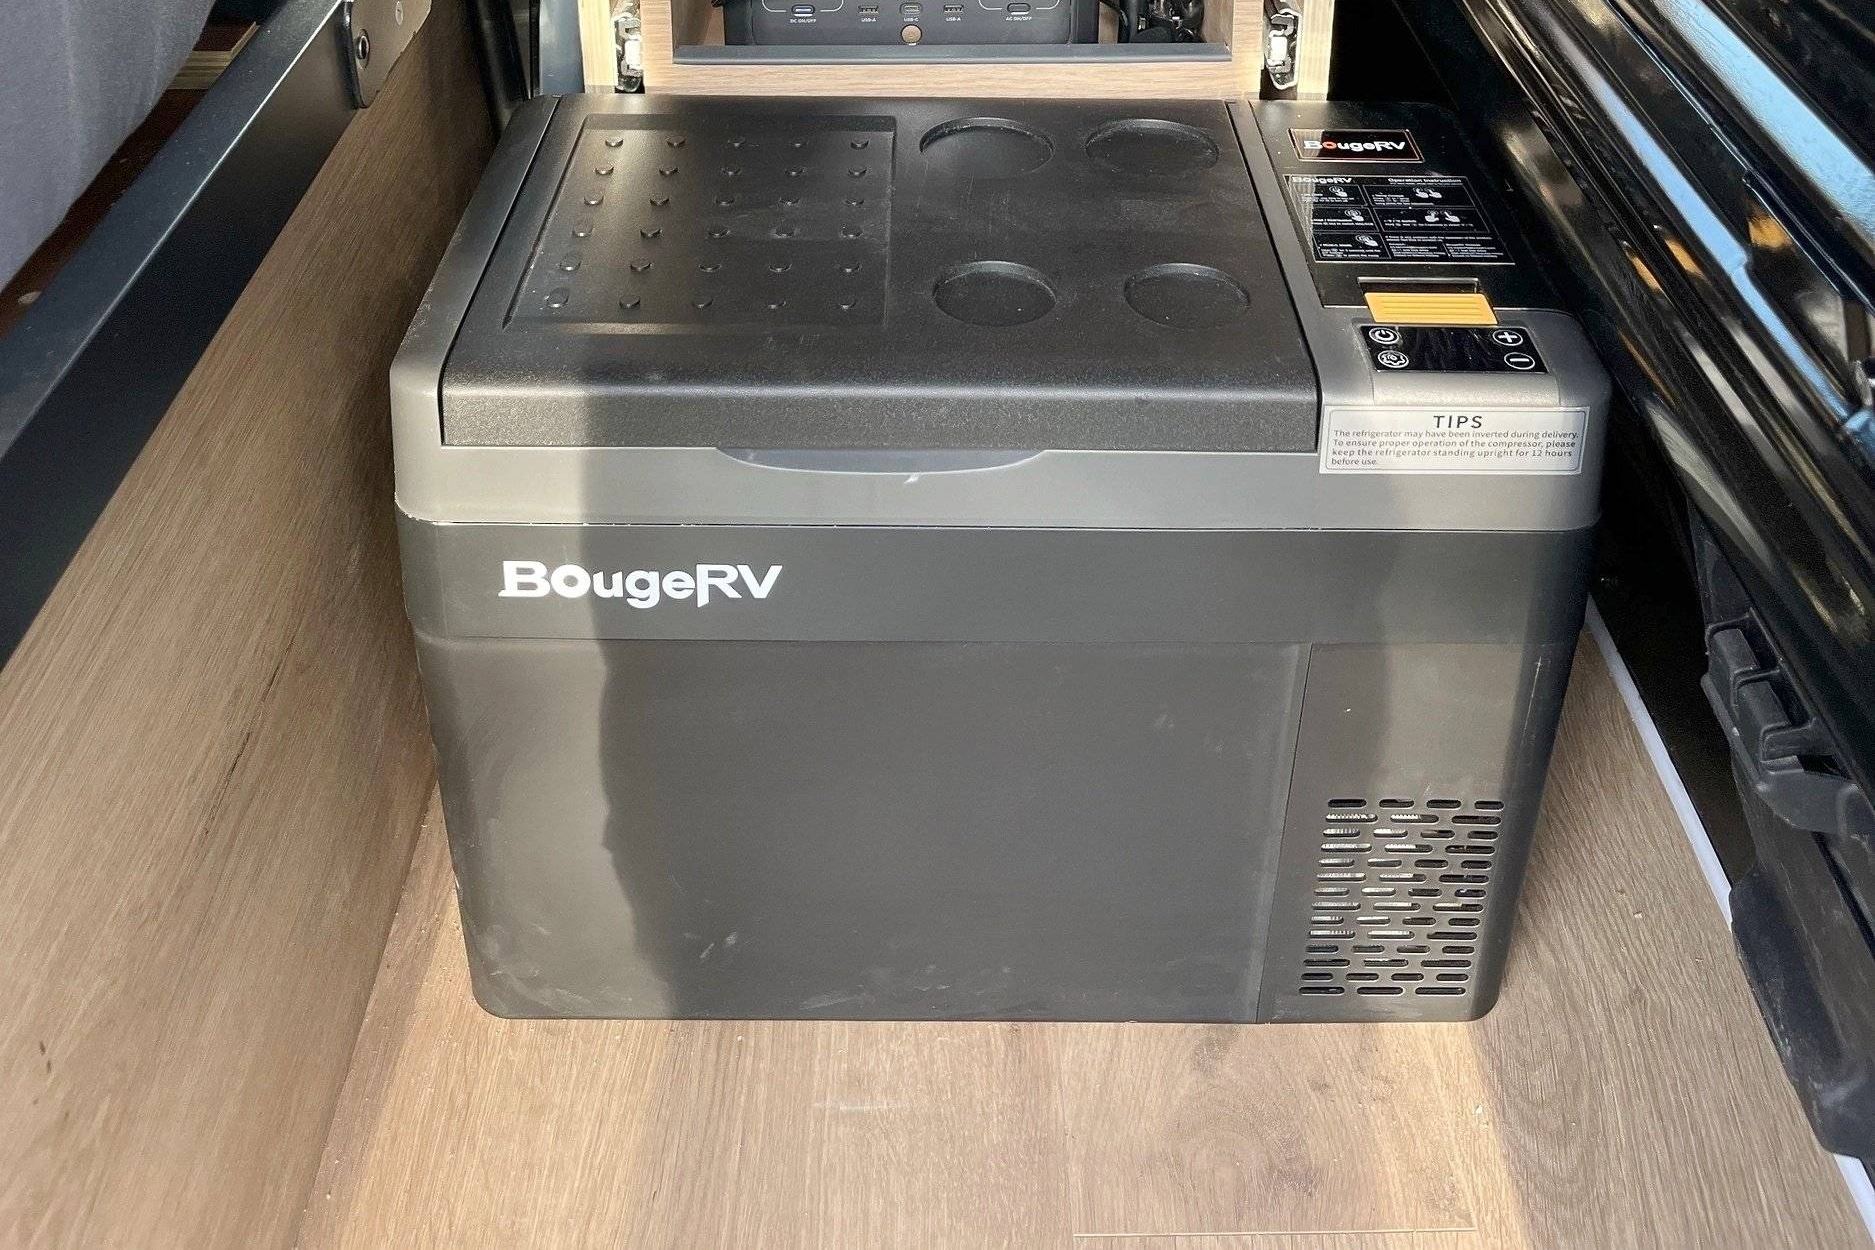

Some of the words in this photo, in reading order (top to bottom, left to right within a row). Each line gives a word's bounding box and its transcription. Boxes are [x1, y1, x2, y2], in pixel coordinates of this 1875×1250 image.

[1433, 415, 1483, 429] TIPS
[1334, 430, 1351, 438] The
[1352, 430, 1402, 439] refrigerator
[1404, 431, 1423, 439] may
[1425, 430, 1447, 438] have
[1449, 430, 1470, 438] been
[1472, 430, 1509, 438] inverted
[1510, 431, 1540, 440] during
[1541, 431, 1580, 440] delivery.
[1333, 439, 1344, 447] To
[1378, 440, 1410, 448] proper
[1412, 439, 1457, 448] operation
[1459, 439, 1469, 447] of
[1470, 439, 1486, 447] the
[1545, 440, 1576, 448] please
[1332, 448, 1355, 457] keep
[1357, 448, 1373, 456] the
[1375, 448, 1431, 458] refrigerator
[1433, 449, 1475, 458] standing
[1477, 449, 1513, 458] upright
[1515, 449, 1530, 457] for
[1532, 449, 1542, 457] 12
[1544, 449, 1573, 457] hours
[1331, 458, 1360, 466] before
